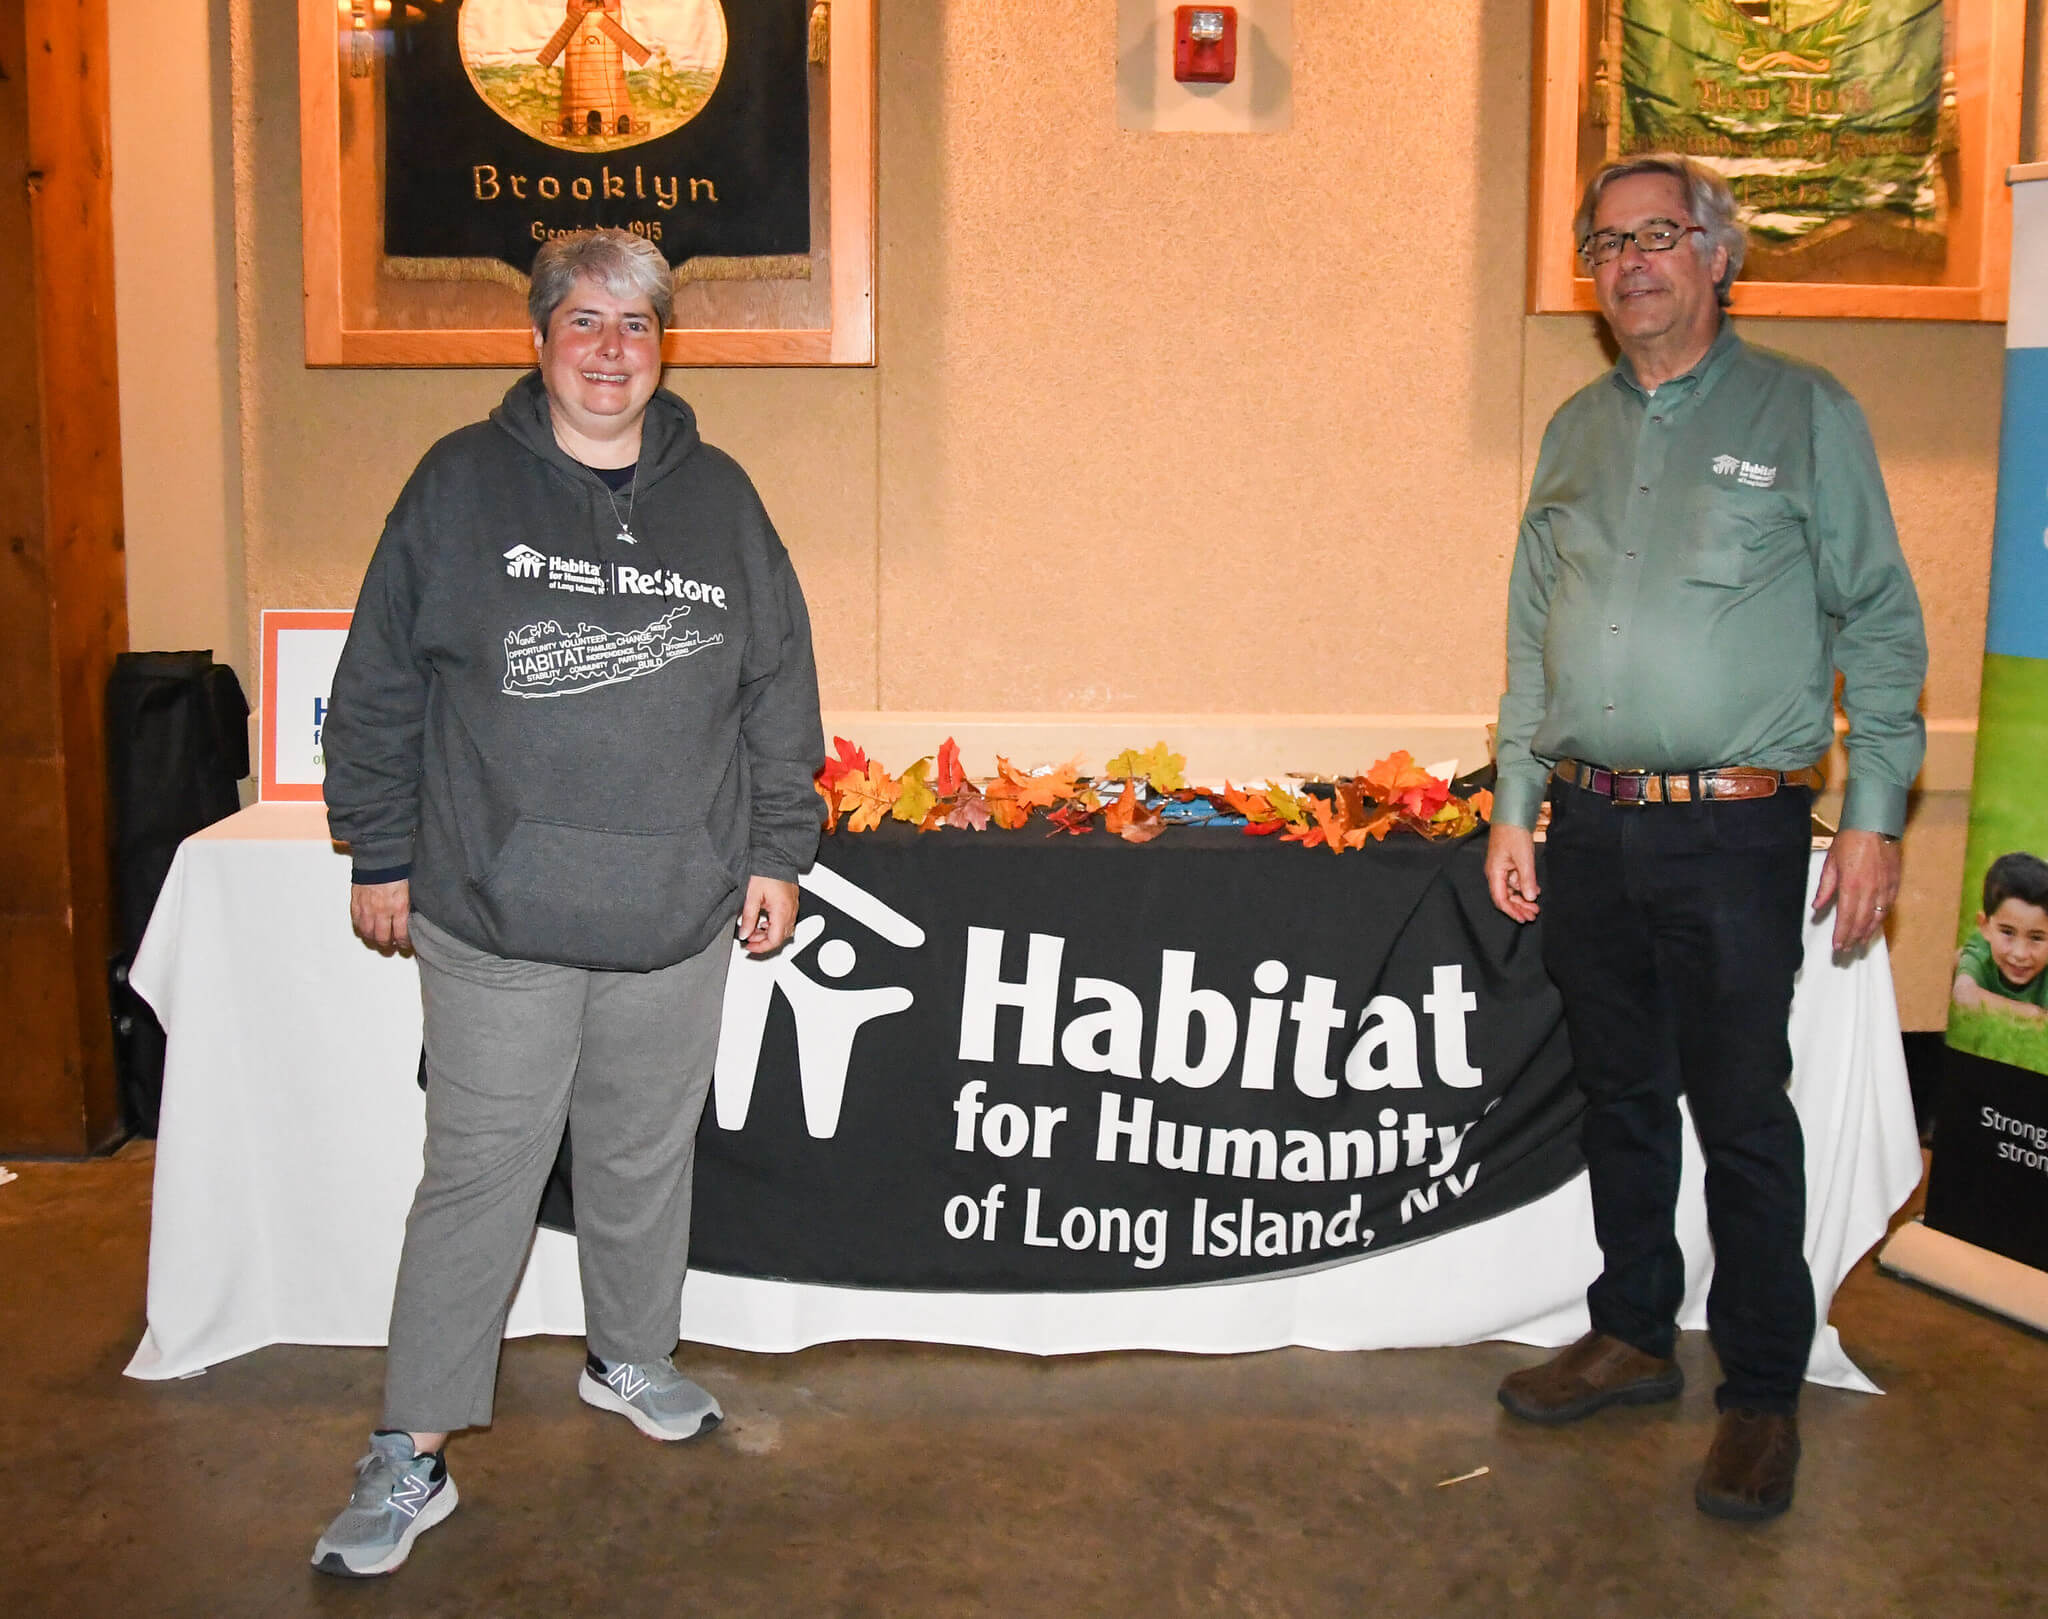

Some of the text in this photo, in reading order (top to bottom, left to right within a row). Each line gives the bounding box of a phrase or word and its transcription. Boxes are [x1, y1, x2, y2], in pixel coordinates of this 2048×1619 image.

[472, 164, 719, 210] Brooklyn
[628, 220, 662, 240] 1915
[549, 556, 601, 577] Habita
[509, 634, 608, 659] OPPORTUNITY VOLUNTEER
[520, 637, 536, 646] GIVE
[587, 642, 617, 654] FAMILIES
[617, 632, 652, 646] CHANGE
[511, 647, 586, 677] HABITAT
[569, 661, 609, 674] COMMUNITY
[618, 652, 649, 665] PARTNER
[638, 658, 663, 670] BUILD
[526, 669, 560, 682] STABILITY
[957, 925, 1484, 1100] Habitat
[953, 1079, 1479, 1183] for Humanity
[1980, 1106, 2048, 1150] Strong
[943, 1184, 1006, 1242] of
[1023, 1187, 1168, 1270] Long
[1192, 1193, 1376, 1258] Island,
